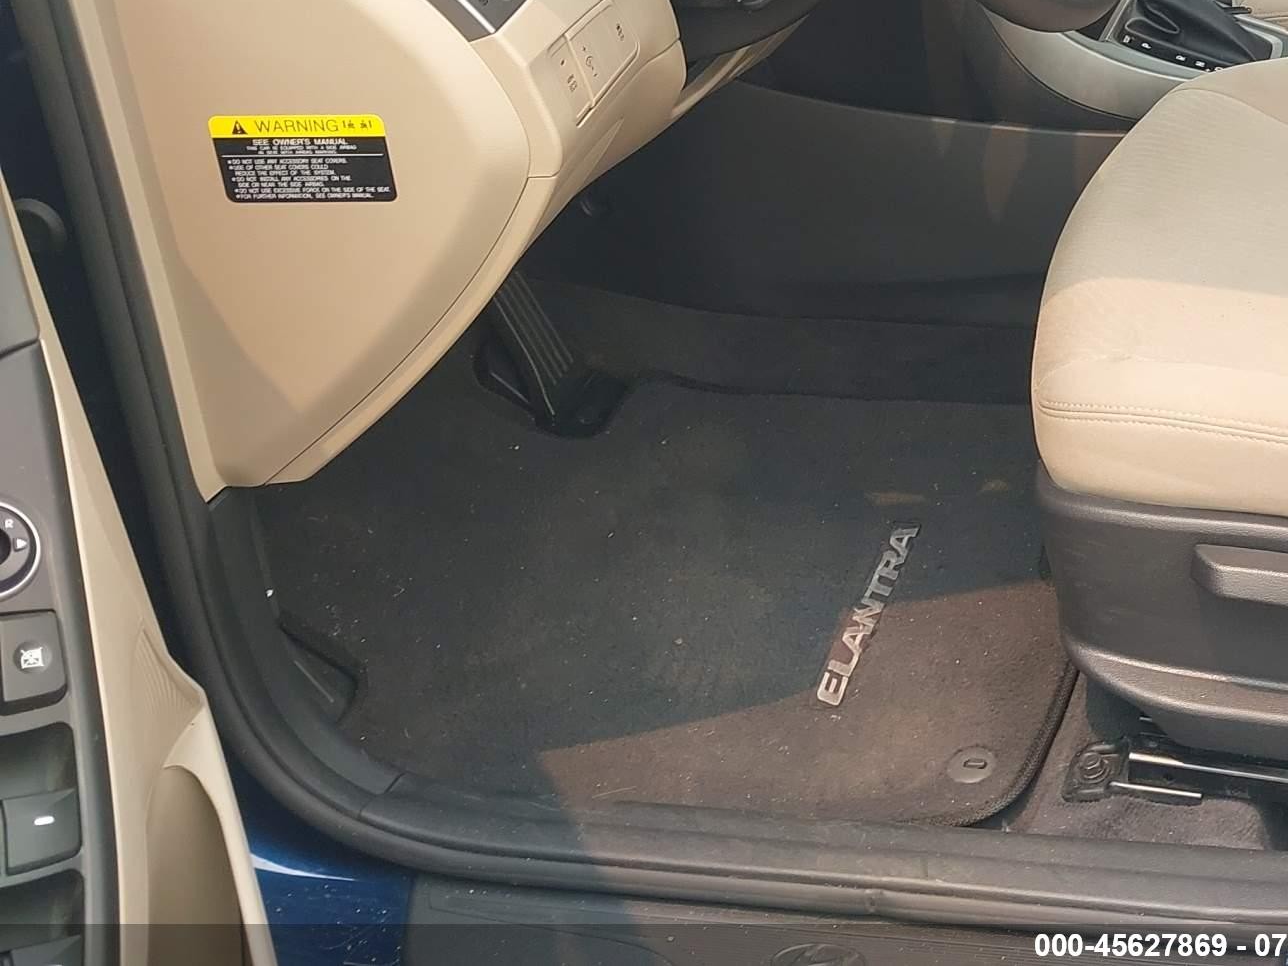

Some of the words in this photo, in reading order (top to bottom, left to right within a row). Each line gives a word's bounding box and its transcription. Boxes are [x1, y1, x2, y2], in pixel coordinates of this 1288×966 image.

[254, 119, 339, 133] WARNING
[5, 519, 14, 529] R
[817, 525, 920, 706] ELANTRA
